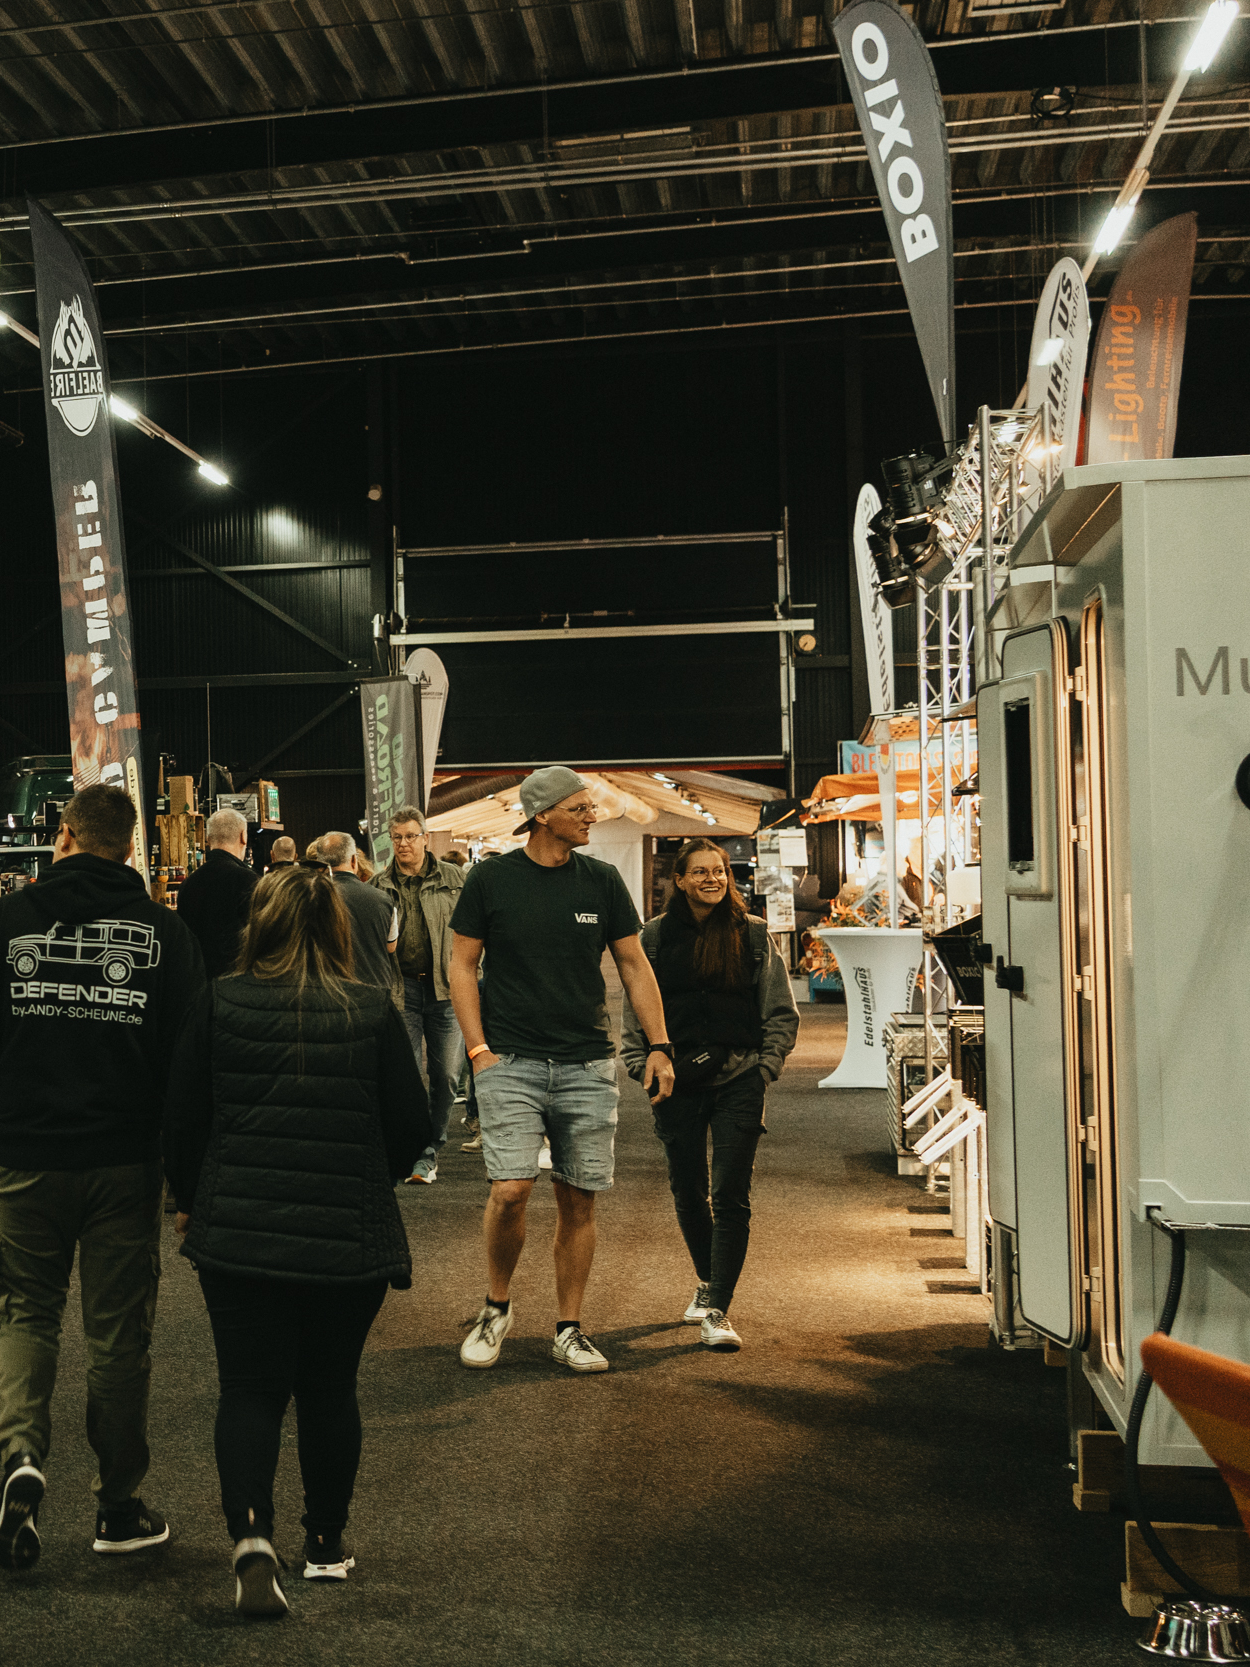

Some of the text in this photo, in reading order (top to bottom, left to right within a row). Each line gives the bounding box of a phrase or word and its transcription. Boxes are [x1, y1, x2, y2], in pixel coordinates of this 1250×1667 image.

[852, 21, 939, 263] BOXIO
[1068, 284, 1081, 339] Profis
[1146, 297, 1165, 389] Beleuchtung für
[1160, 296, 1179, 389] Fernreisemobile
[574, 912, 599, 924] VANS
[10, 980, 148, 1009] DEFENDER
